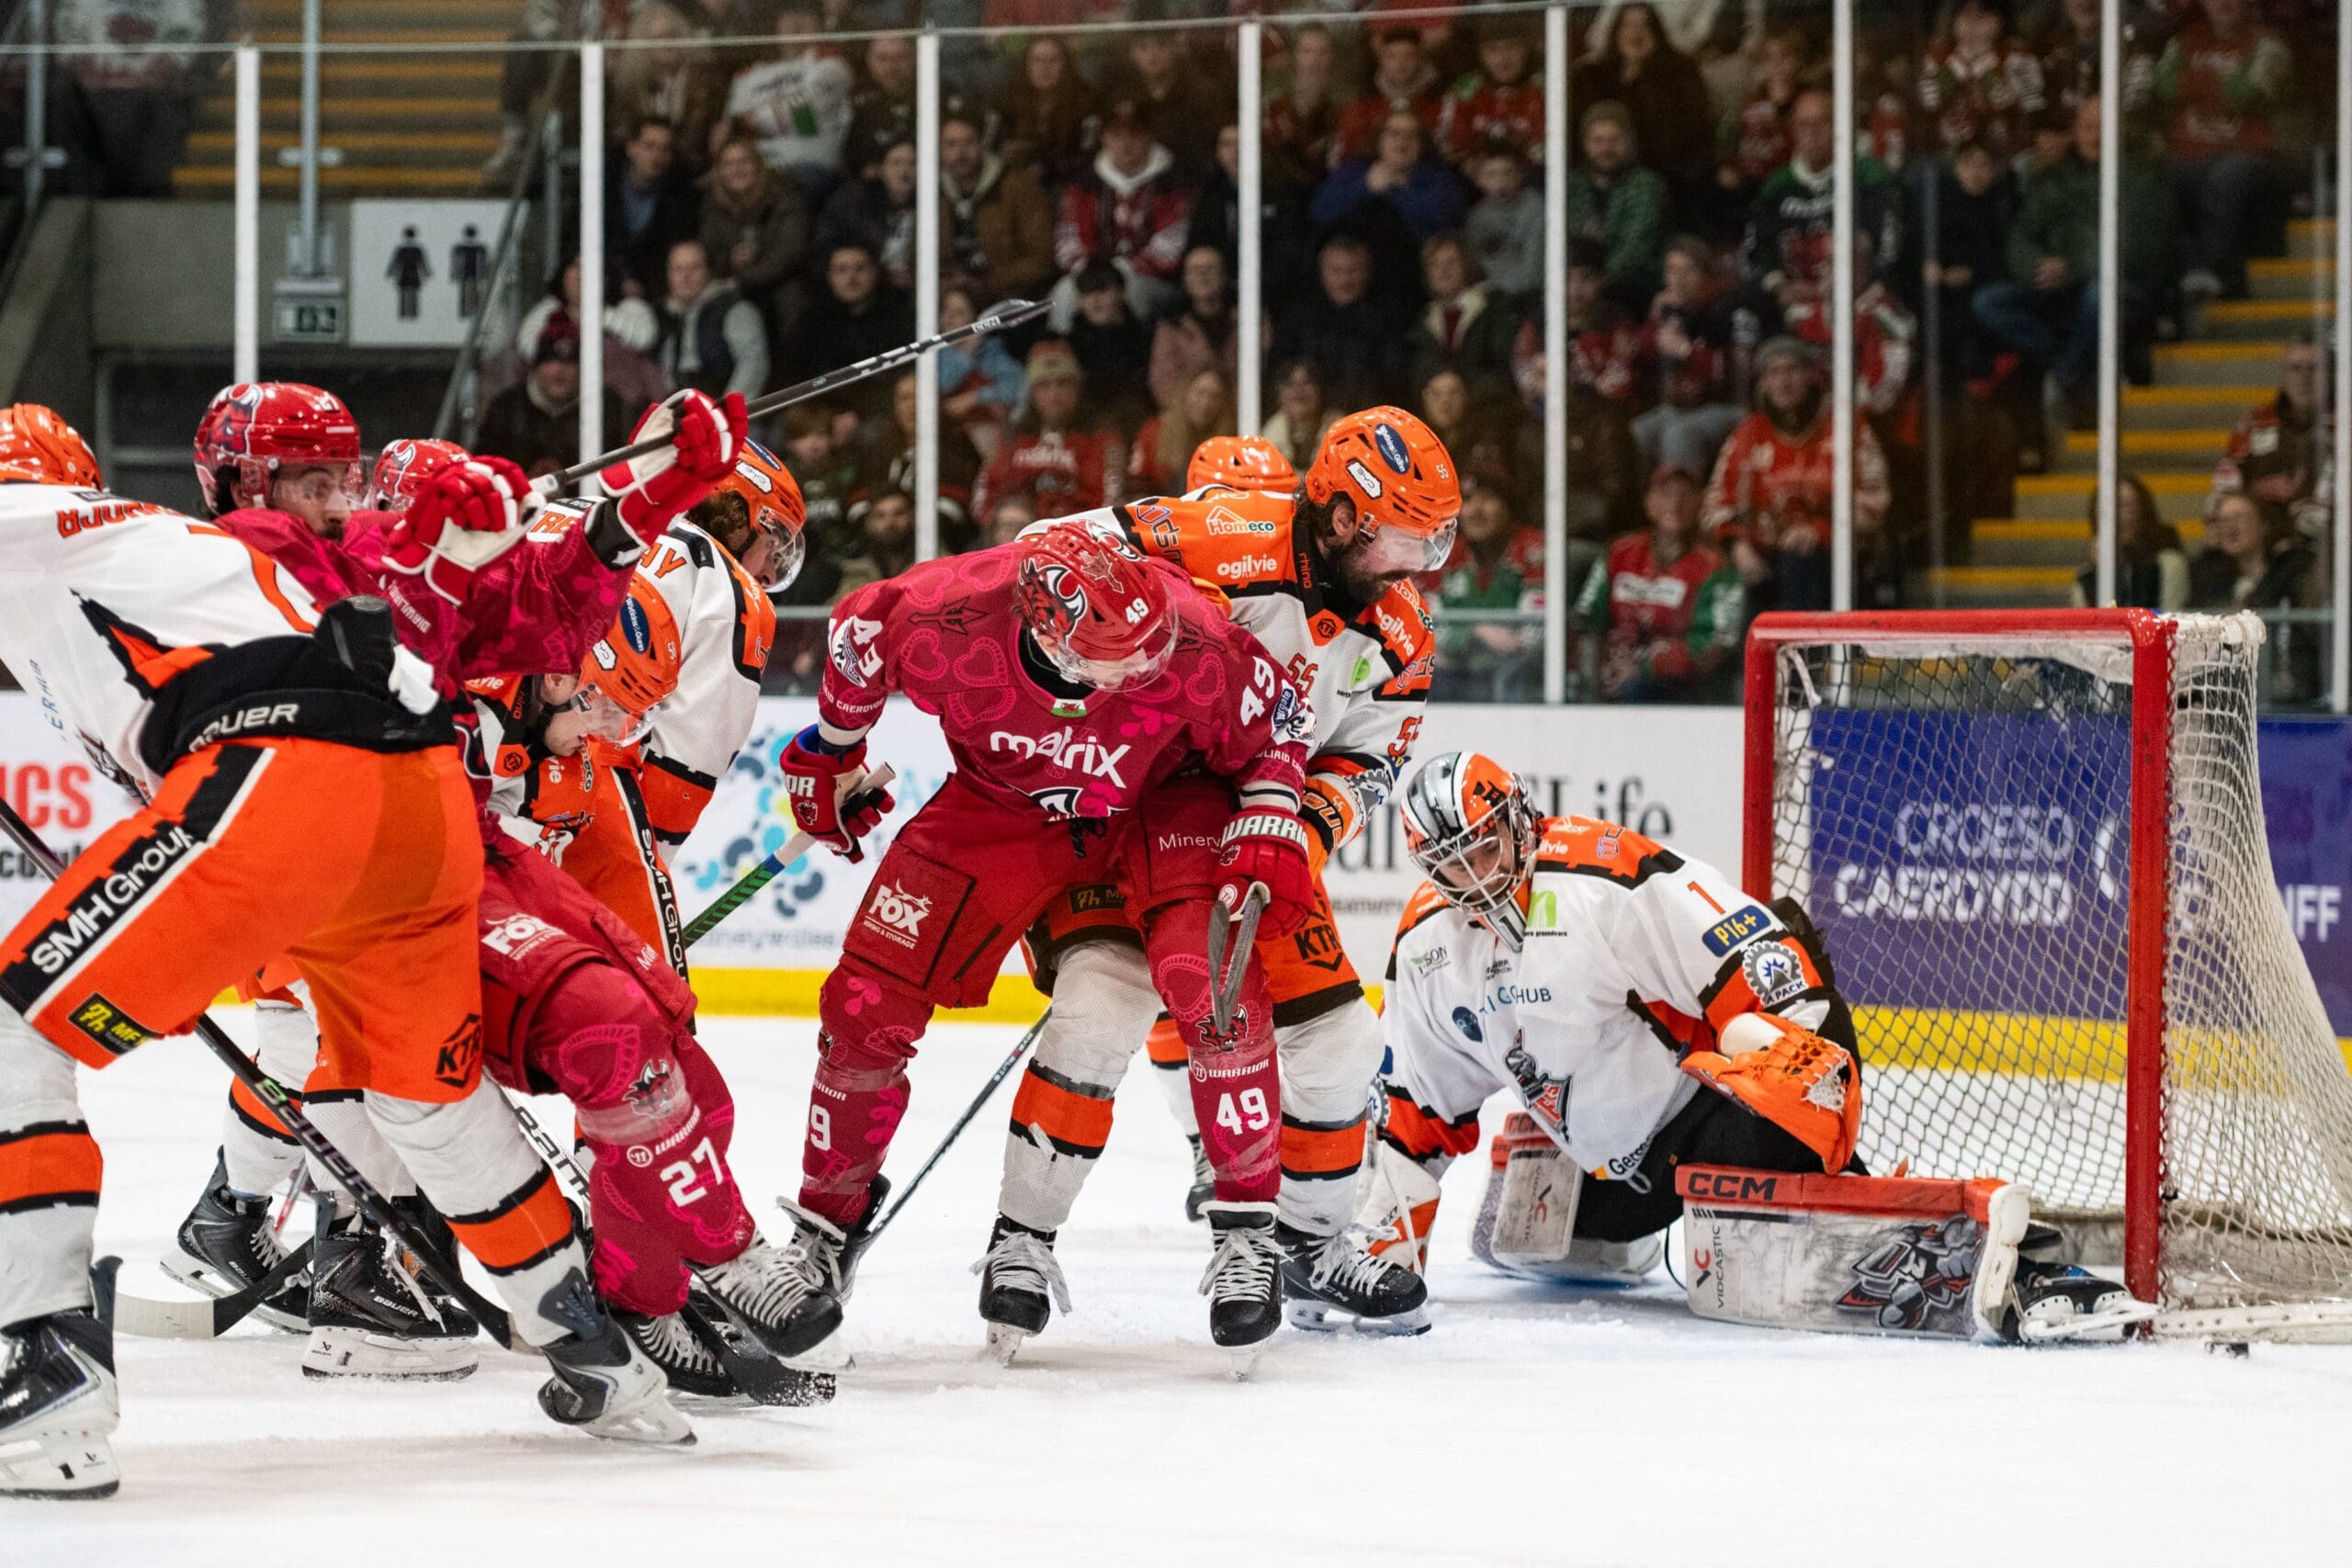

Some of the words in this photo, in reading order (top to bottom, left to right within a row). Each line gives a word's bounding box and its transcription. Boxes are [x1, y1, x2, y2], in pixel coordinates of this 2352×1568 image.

[1217, 554, 1278, 580] ogilvie
[1124, 597, 1149, 624] 49
[1240, 656, 1275, 727] 49
[989, 725, 1132, 789] matrix
[1159, 832, 1222, 852] Minerv
[1222, 815, 1308, 858] WARRI
[868, 884, 930, 935] FOX
[1686, 881, 1726, 915] 1
[30, 893, 115, 974] SMH
[664, 903, 687, 981] Grou
[885, 931, 916, 951] STORAGE
[1713, 913, 1758, 947] P16+
[1776, 979, 1806, 1000] PACK
[1208, 1058, 1270, 1078] WARRIOR
[806, 1103, 831, 1152] 9
[1216, 1087, 1270, 1135] 49
[659, 1136, 724, 1207] 27
[1688, 1172, 1778, 1201] CCM
[1712, 1224, 1725, 1309] VIDCASTIC
[372, 1294, 419, 1318] BAUER
